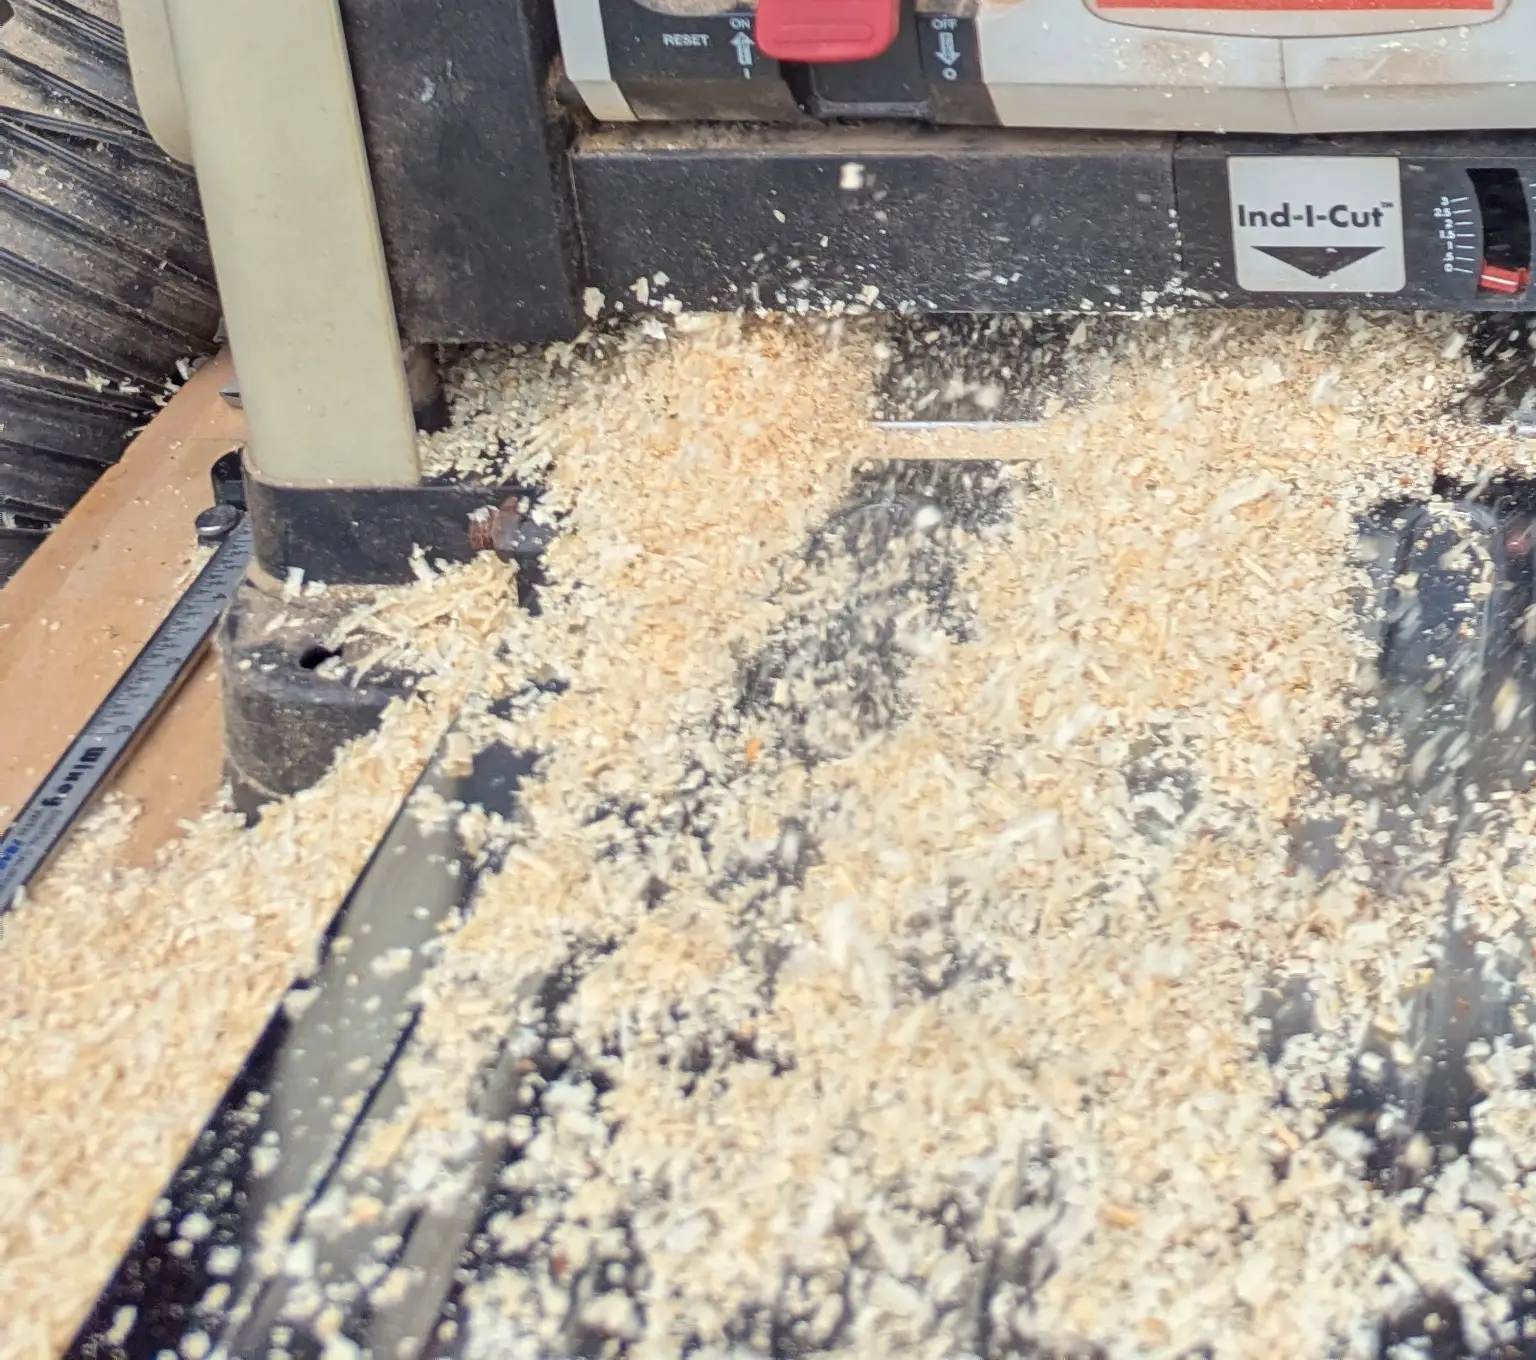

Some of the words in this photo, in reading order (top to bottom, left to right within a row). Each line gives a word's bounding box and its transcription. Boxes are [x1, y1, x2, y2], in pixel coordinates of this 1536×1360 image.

[662, 34, 709, 48] RESET
[729, 18, 751, 29] ON
[931, 18, 958, 30] OFF
[1440, 196, 1450, 206] 3
[1446, 241, 1454, 250] 1
[1444, 263, 1453, 272] 0
